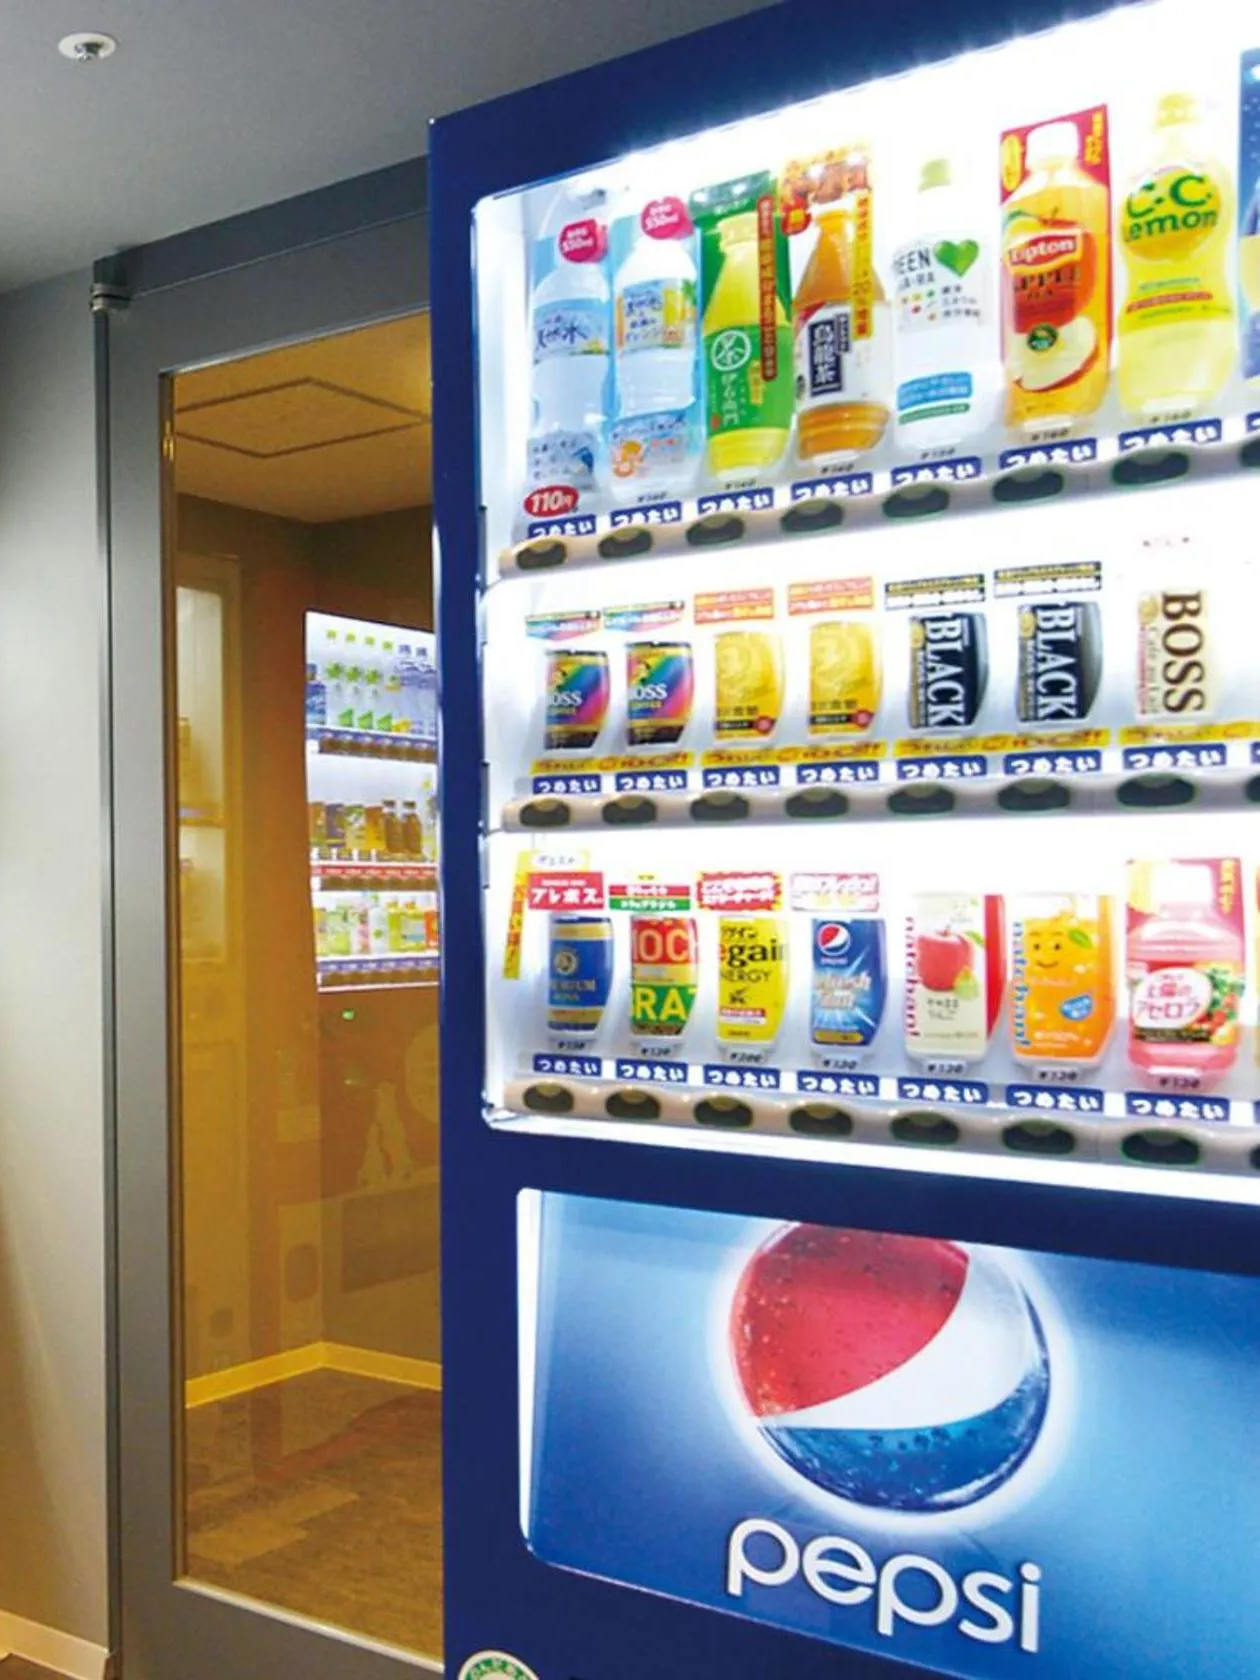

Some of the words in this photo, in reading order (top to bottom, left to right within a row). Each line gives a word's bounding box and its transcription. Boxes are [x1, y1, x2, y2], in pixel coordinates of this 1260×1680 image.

[1125, 210, 1217, 243] emon
[1009, 240, 1075, 264] Lipton
[1036, 605, 1077, 719] BLACK
[1161, 591, 1205, 713] BOSS
[925, 616, 966, 726] BLACK
[537, 1058, 598, 1075] つめたい
[620, 1063, 685, 1081] つめたい
[708, 1068, 778, 1088] つめたい
[802, 1076, 875, 1095] つめたい
[902, 1083, 982, 1103] つめたい
[1013, 1091, 1099, 1111] つめたい
[1131, 1098, 1225, 1120] つめたい
[727, 1517, 1042, 1654] pepsi
